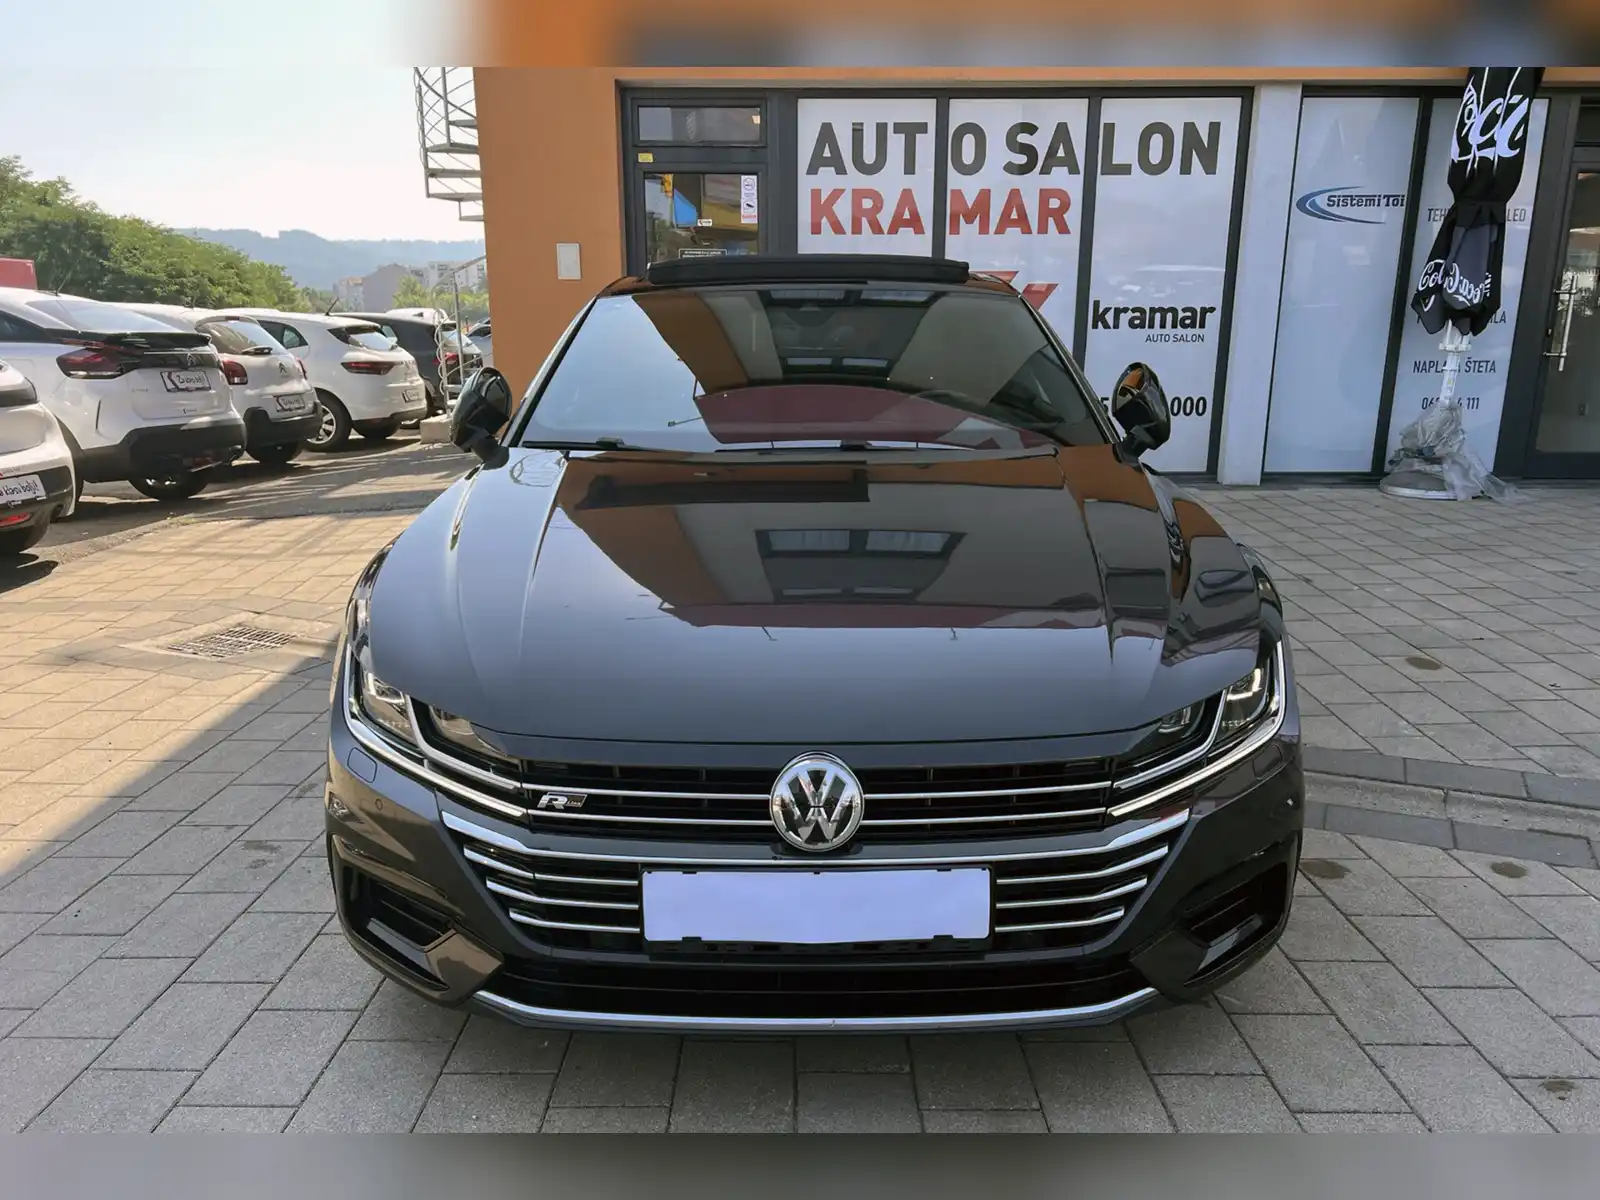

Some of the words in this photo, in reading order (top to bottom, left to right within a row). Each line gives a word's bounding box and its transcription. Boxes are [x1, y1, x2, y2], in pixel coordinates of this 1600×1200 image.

[806, 121, 986, 176] AUTO
[1003, 121, 1221, 176] SALON
[810, 188, 1072, 236] KRAMAR
[1326, 194, 1381, 207] Sistemi
[1091, 300, 1217, 330] kramar
[1145, 333, 1170, 343] AUTO
[1172, 333, 1205, 343] SALON
[1464, 356, 1496, 373] ŠTETA
